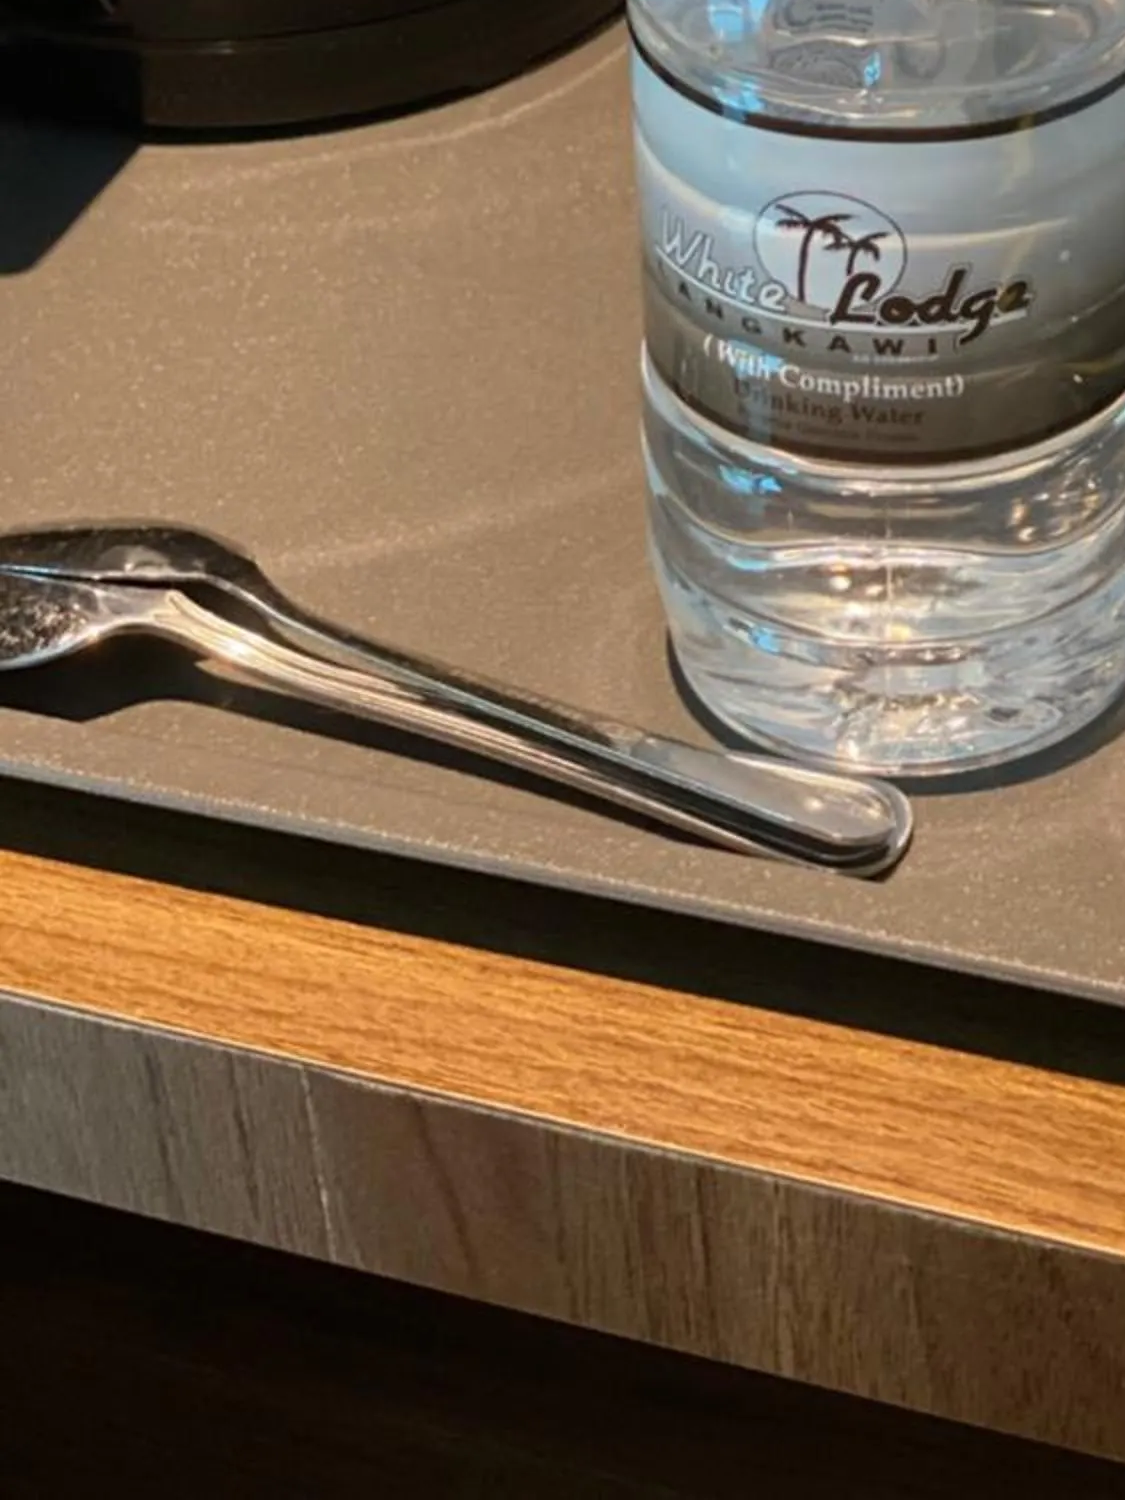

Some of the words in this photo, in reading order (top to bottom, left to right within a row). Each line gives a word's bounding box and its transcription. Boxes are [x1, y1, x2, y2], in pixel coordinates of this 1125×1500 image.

[661, 207, 787, 311] White
[828, 266, 1031, 345] Lodge
[779, 363, 965, 402] Compliment)
